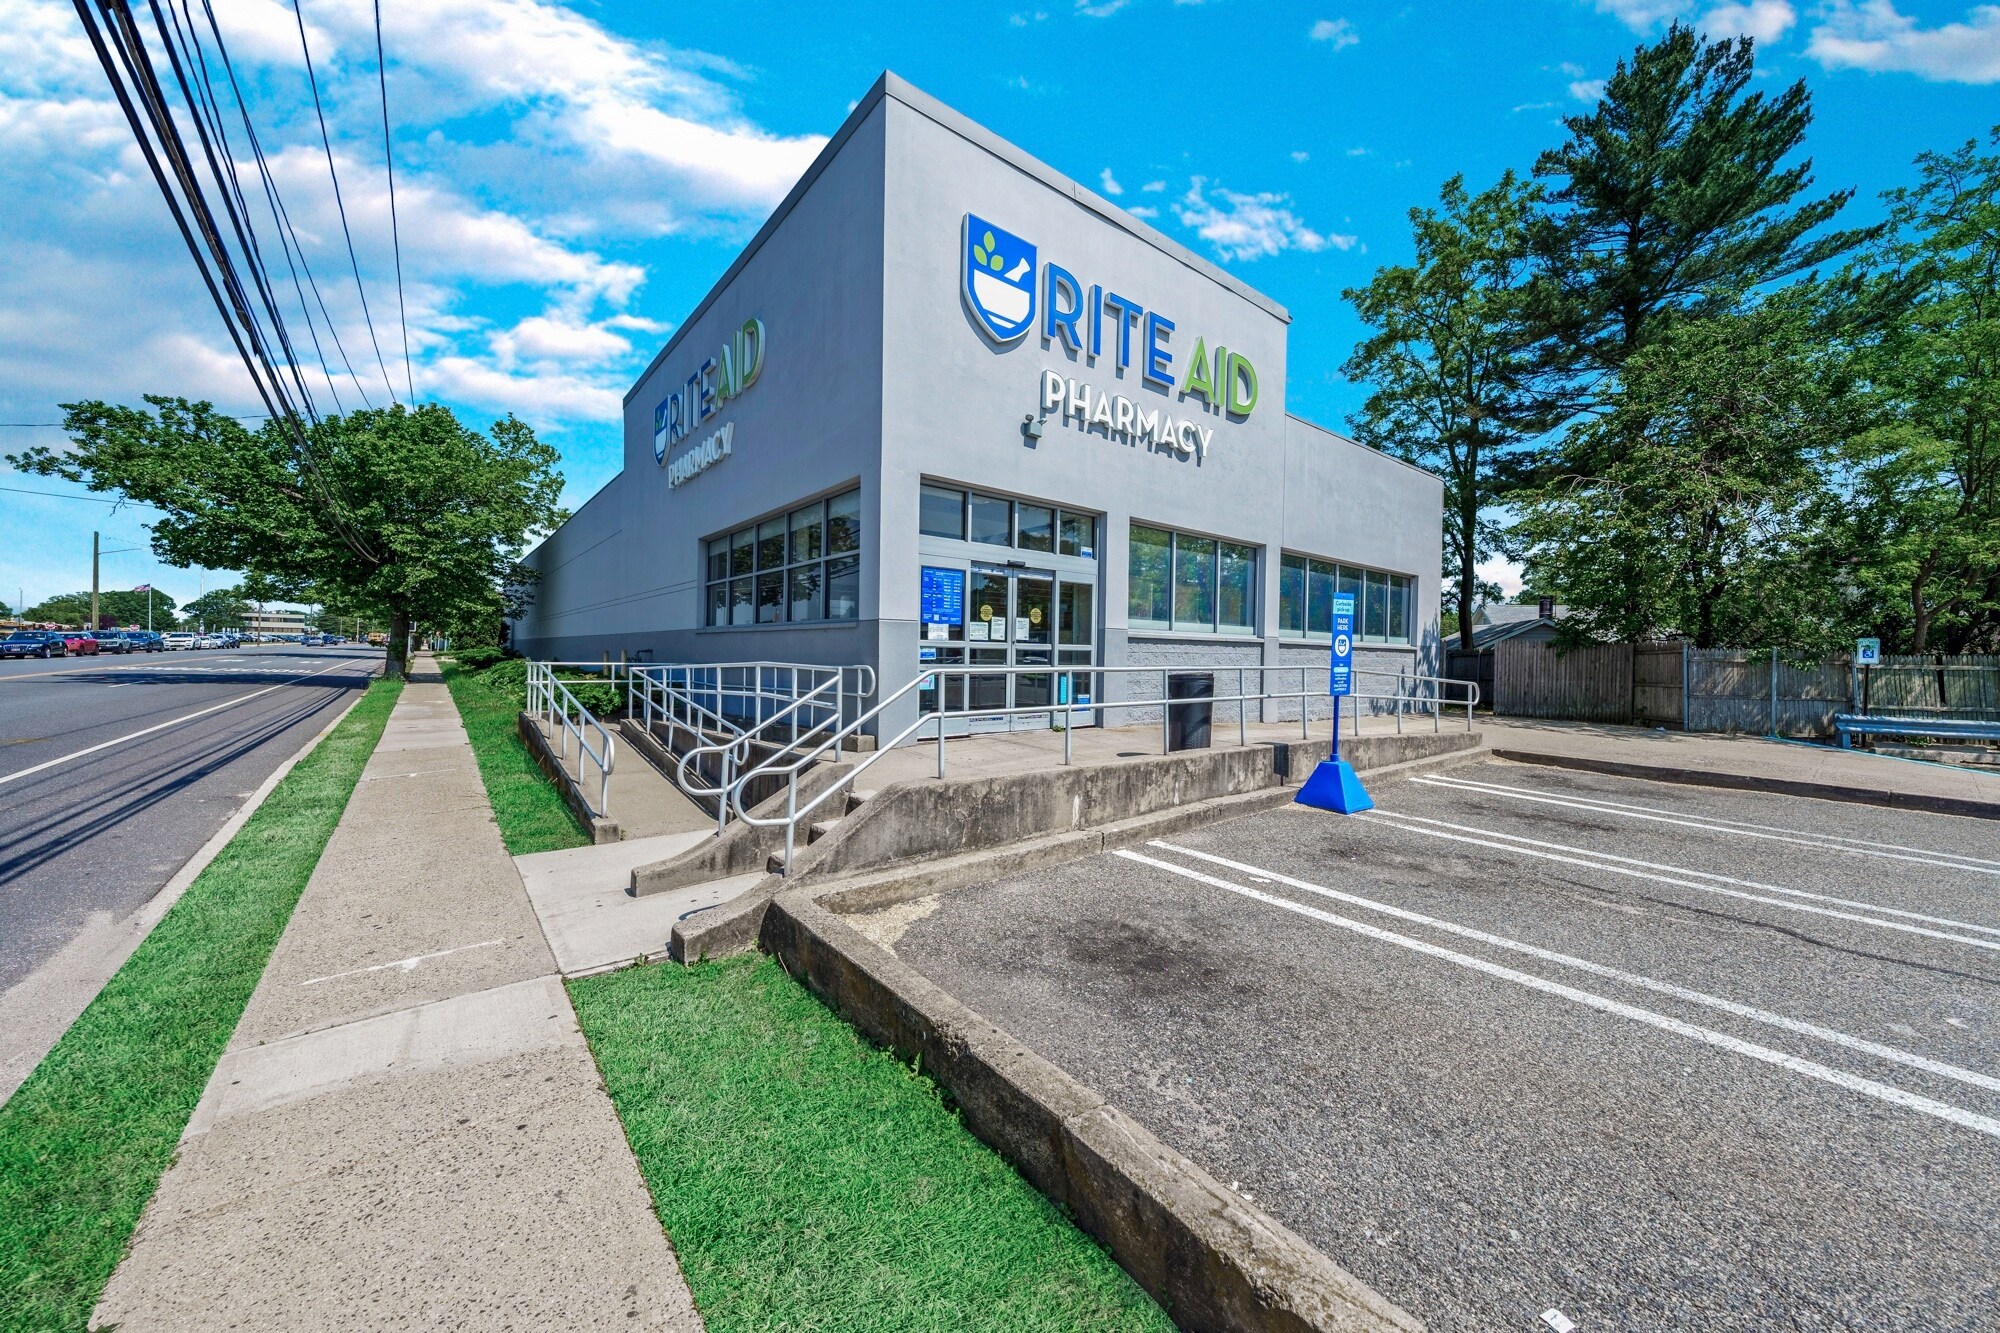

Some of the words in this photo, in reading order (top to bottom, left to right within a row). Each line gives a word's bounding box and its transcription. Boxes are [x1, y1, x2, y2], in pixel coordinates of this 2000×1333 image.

[670, 357, 717, 446] RITE
[715, 318, 766, 409] AID
[1043, 262, 1176, 387] RITE
[1180, 336, 1258, 415] AID
[668, 421, 735, 489] PHARMACY
[1042, 369, 1214, 457] PHARMACY
